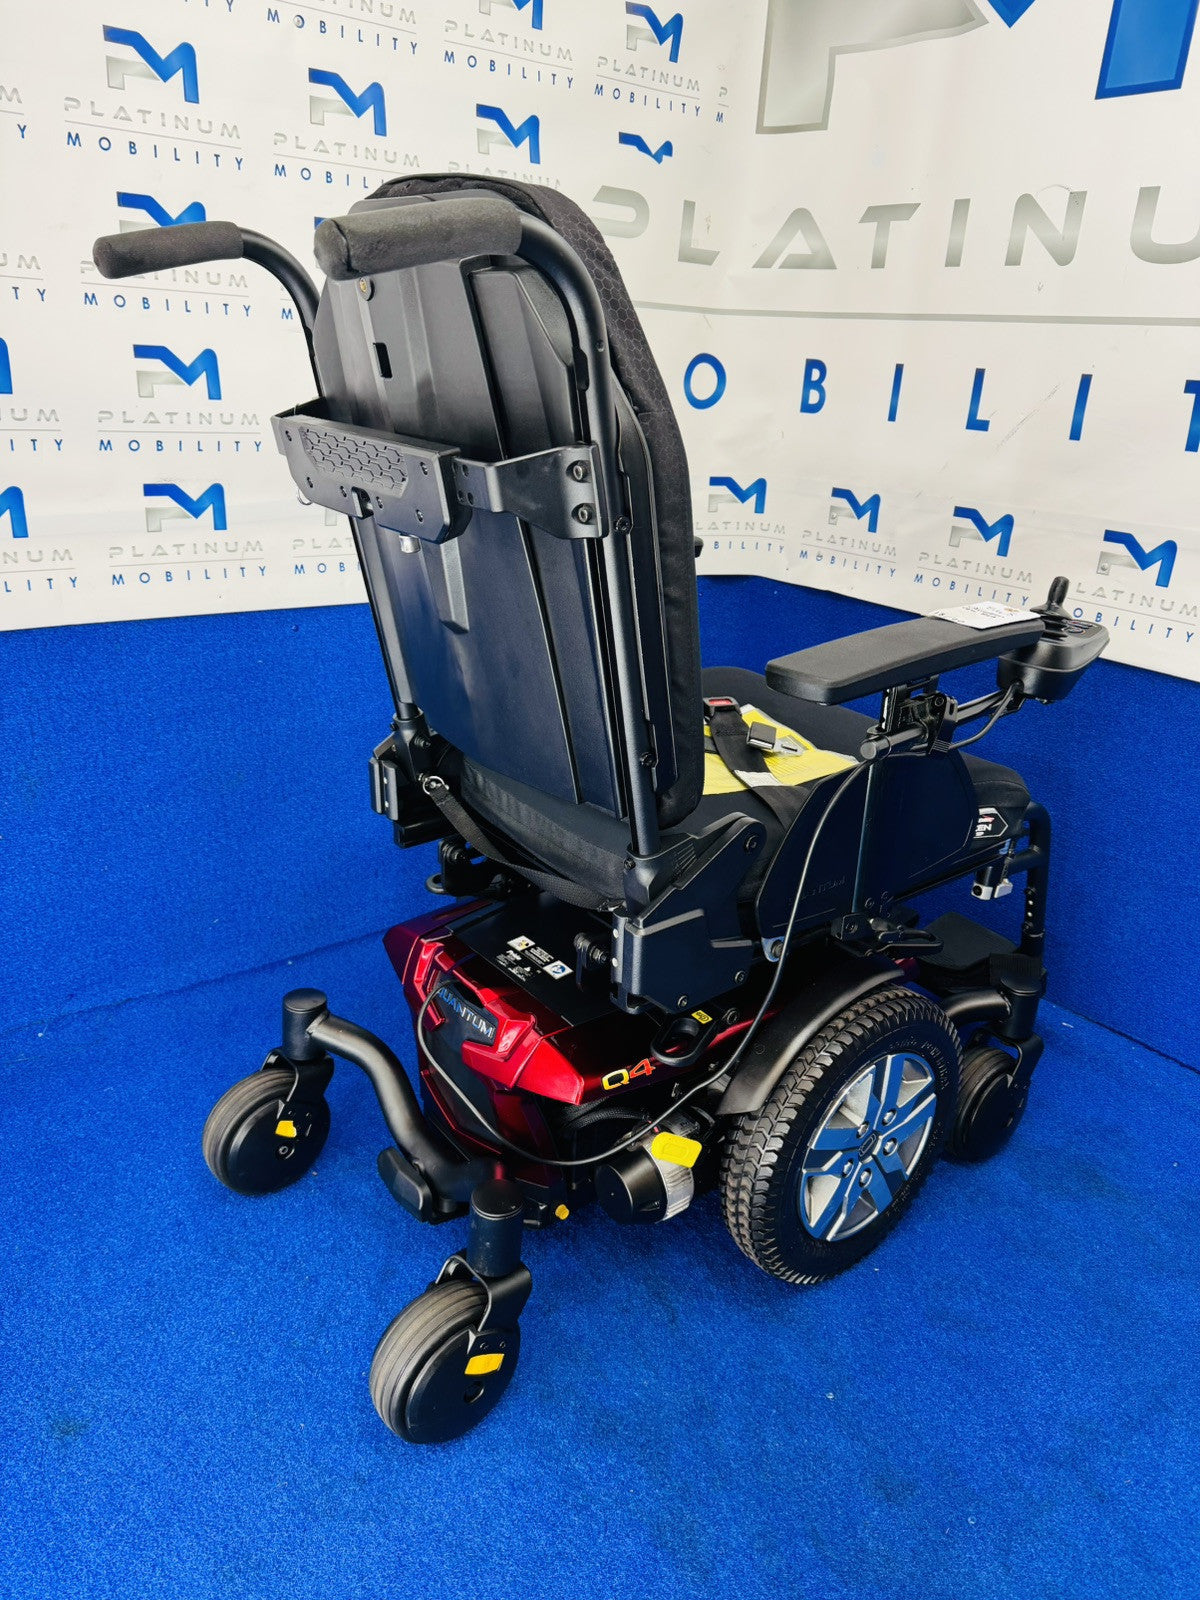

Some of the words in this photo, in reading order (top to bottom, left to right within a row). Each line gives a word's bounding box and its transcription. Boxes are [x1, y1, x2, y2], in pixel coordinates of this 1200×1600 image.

[445, 20, 573, 61] PLATINUM
[444, 50, 573, 89] MOBILITY
[597, 55, 701, 92] PLATINUM
[594, 83, 701, 117] MOBILITY
[64, 96, 241, 140] PLATINUM
[66, 131, 244, 171] MOBILITY
[273, 132, 421, 168] PLATINUM
[274, 163, 370, 189] MOBIL
[84, 292, 252, 318] MOBILITY
[98, 409, 261, 427] PLATINUM
[99, 439, 262, 453] MOBILITY
[696, 520, 786, 535] LATINUM
[801, 529, 897, 557] PLATINUM
[108, 540, 264, 559] PLATINUM
[713, 540, 785, 554] BILITY
[111, 565, 267, 586] MOBILITY
[918, 551, 1034, 584] PLATINUM
[913, 573, 1030, 607] MOBILITY
[1076, 581, 1199, 618] LATINUM
[1073, 607, 1194, 643] OBILITY
